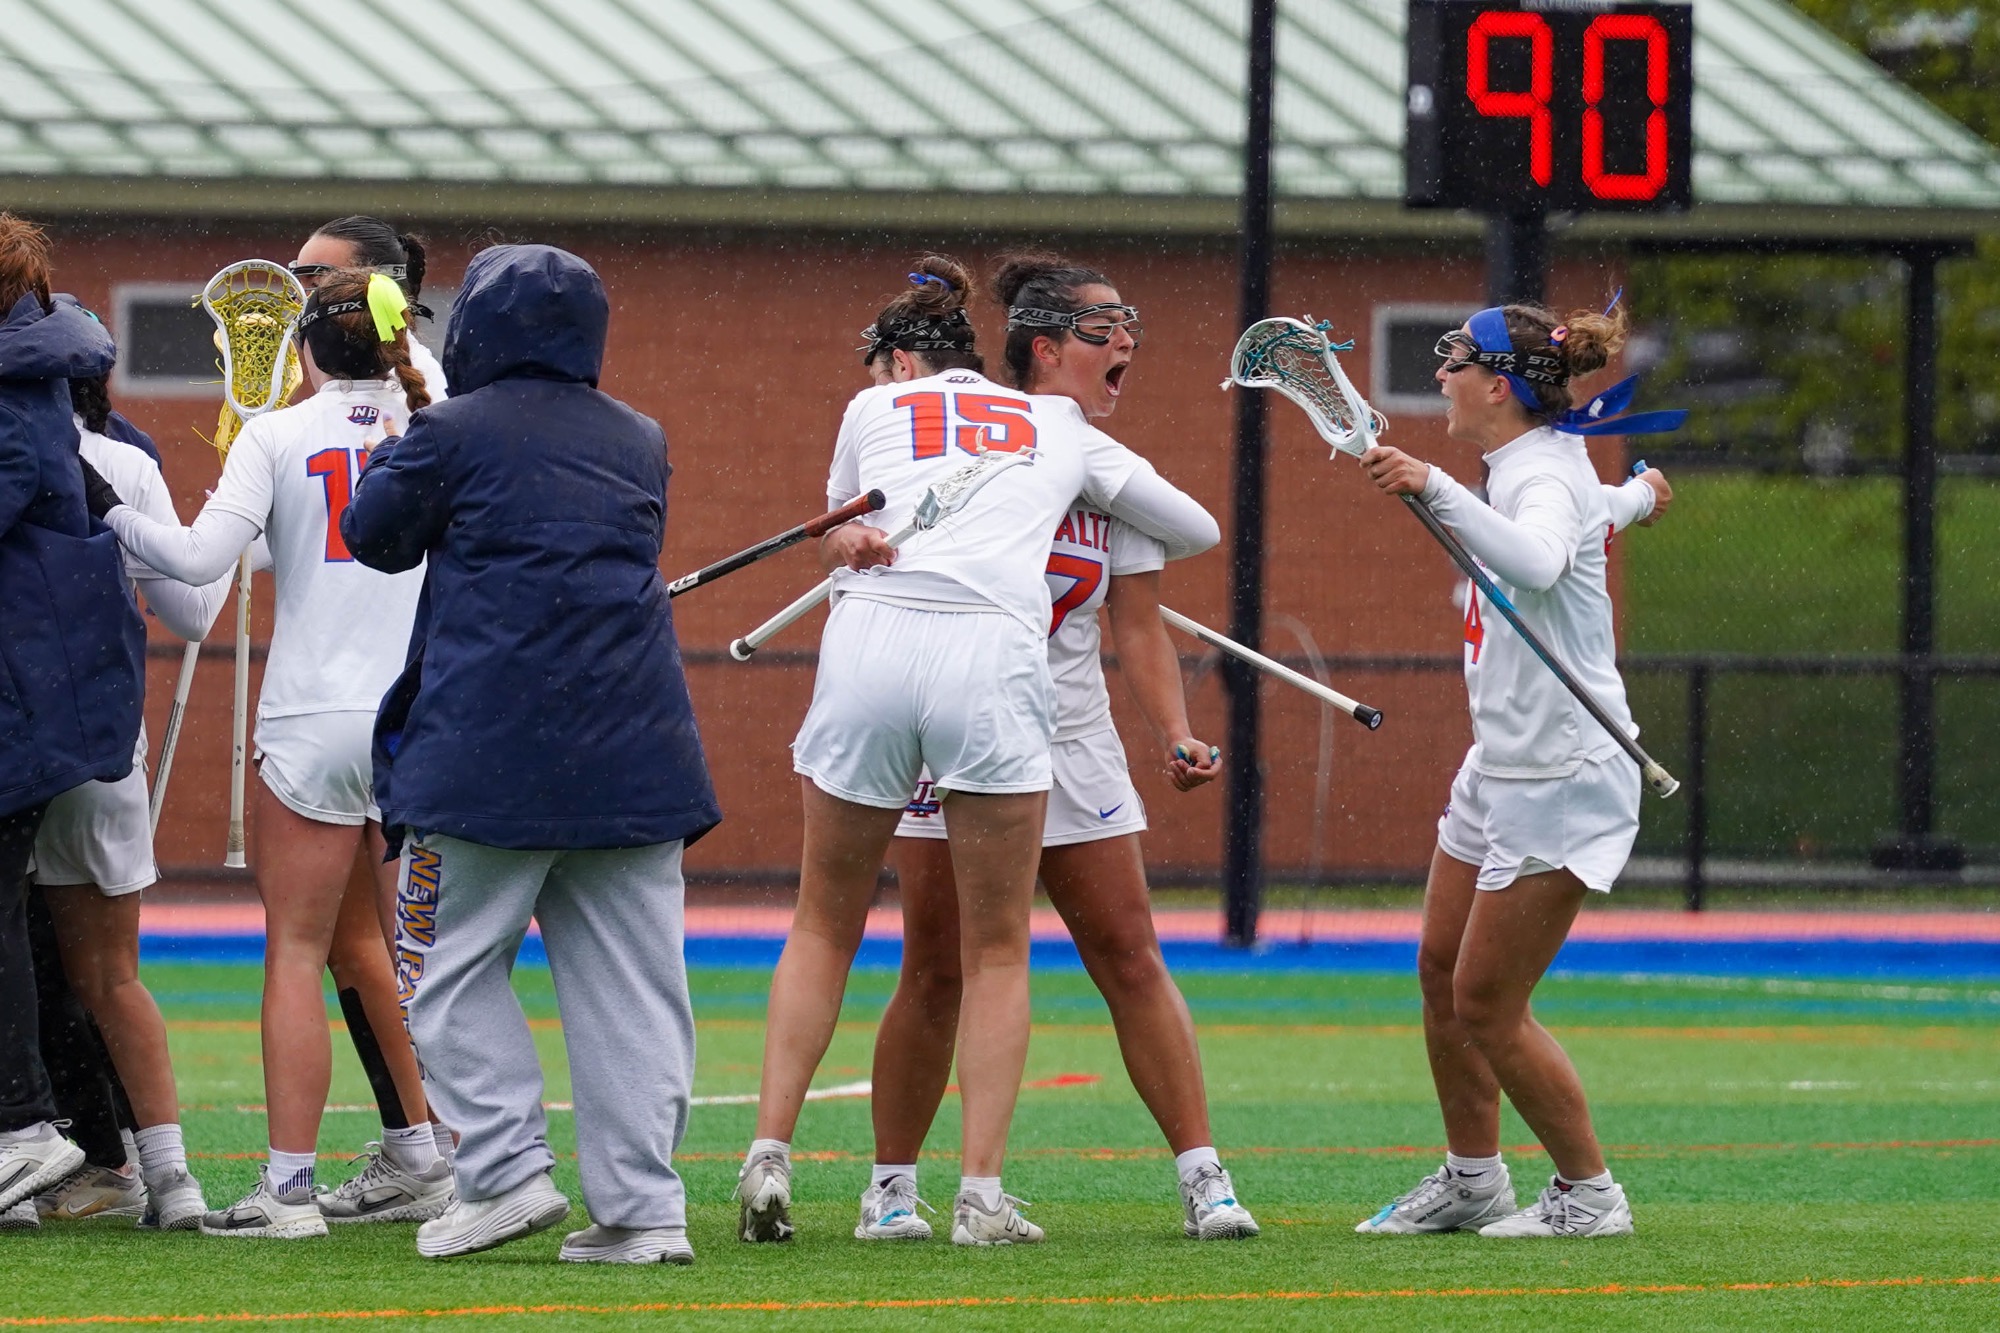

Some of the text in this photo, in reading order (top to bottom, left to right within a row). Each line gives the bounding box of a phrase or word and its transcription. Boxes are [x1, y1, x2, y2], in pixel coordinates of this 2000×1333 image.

[1467, 12, 1668, 199] 90
[327, 300, 363, 315] STX
[301, 310, 320, 328] STX
[914, 340, 956, 350] STX
[1478, 353, 1516, 362] STX
[1527, 355, 1560, 367] STX
[1524, 368, 1556, 384] STX
[893, 391, 1038, 461] 15
[306, 448, 368, 563] 1
[407, 842, 442, 948] NEW
[1426, 1200, 1453, 1218] balance
